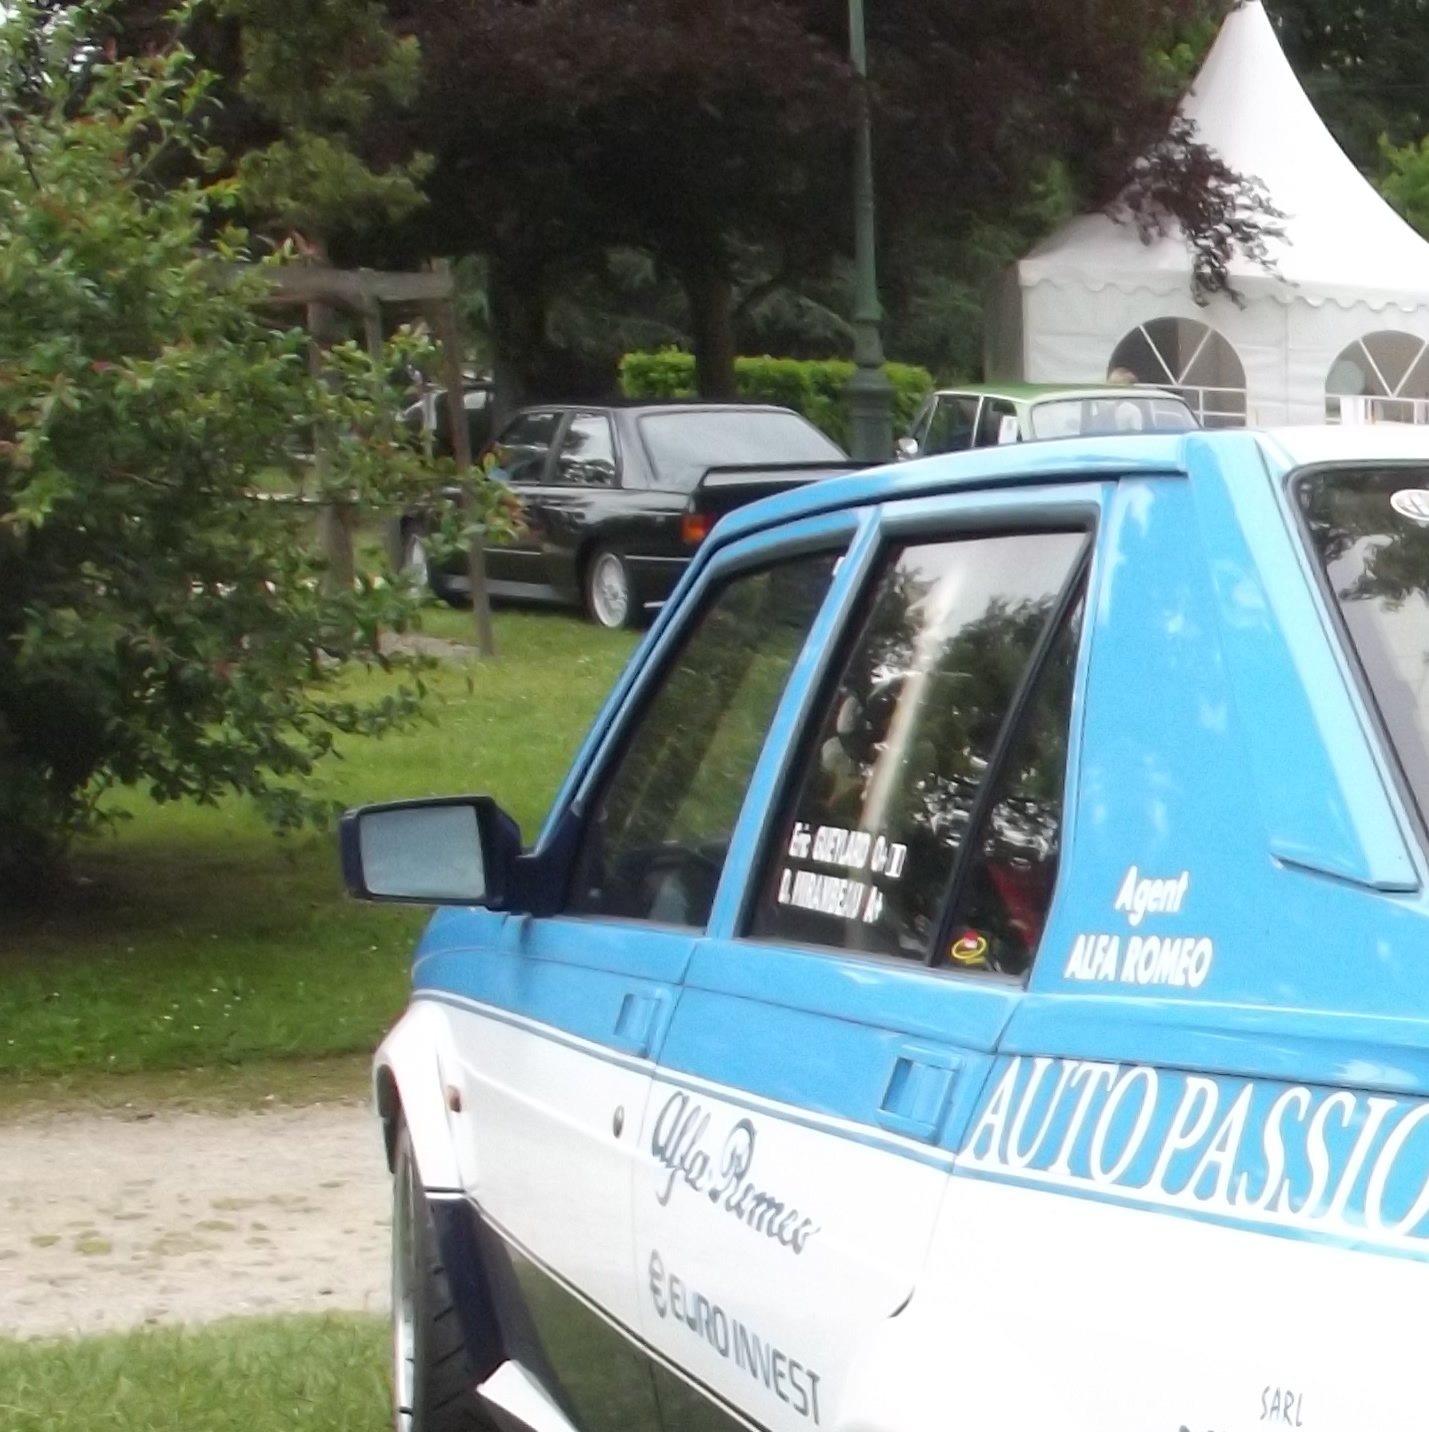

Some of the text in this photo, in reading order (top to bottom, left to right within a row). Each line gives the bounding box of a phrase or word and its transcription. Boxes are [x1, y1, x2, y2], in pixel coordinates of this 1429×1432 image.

[1114, 865, 1190, 926] Agent
[1063, 934, 1213, 987] ALFA ROMEO
[956, 1055, 1159, 1183] AUTO
[1259, 1385, 1304, 1427] SARL
